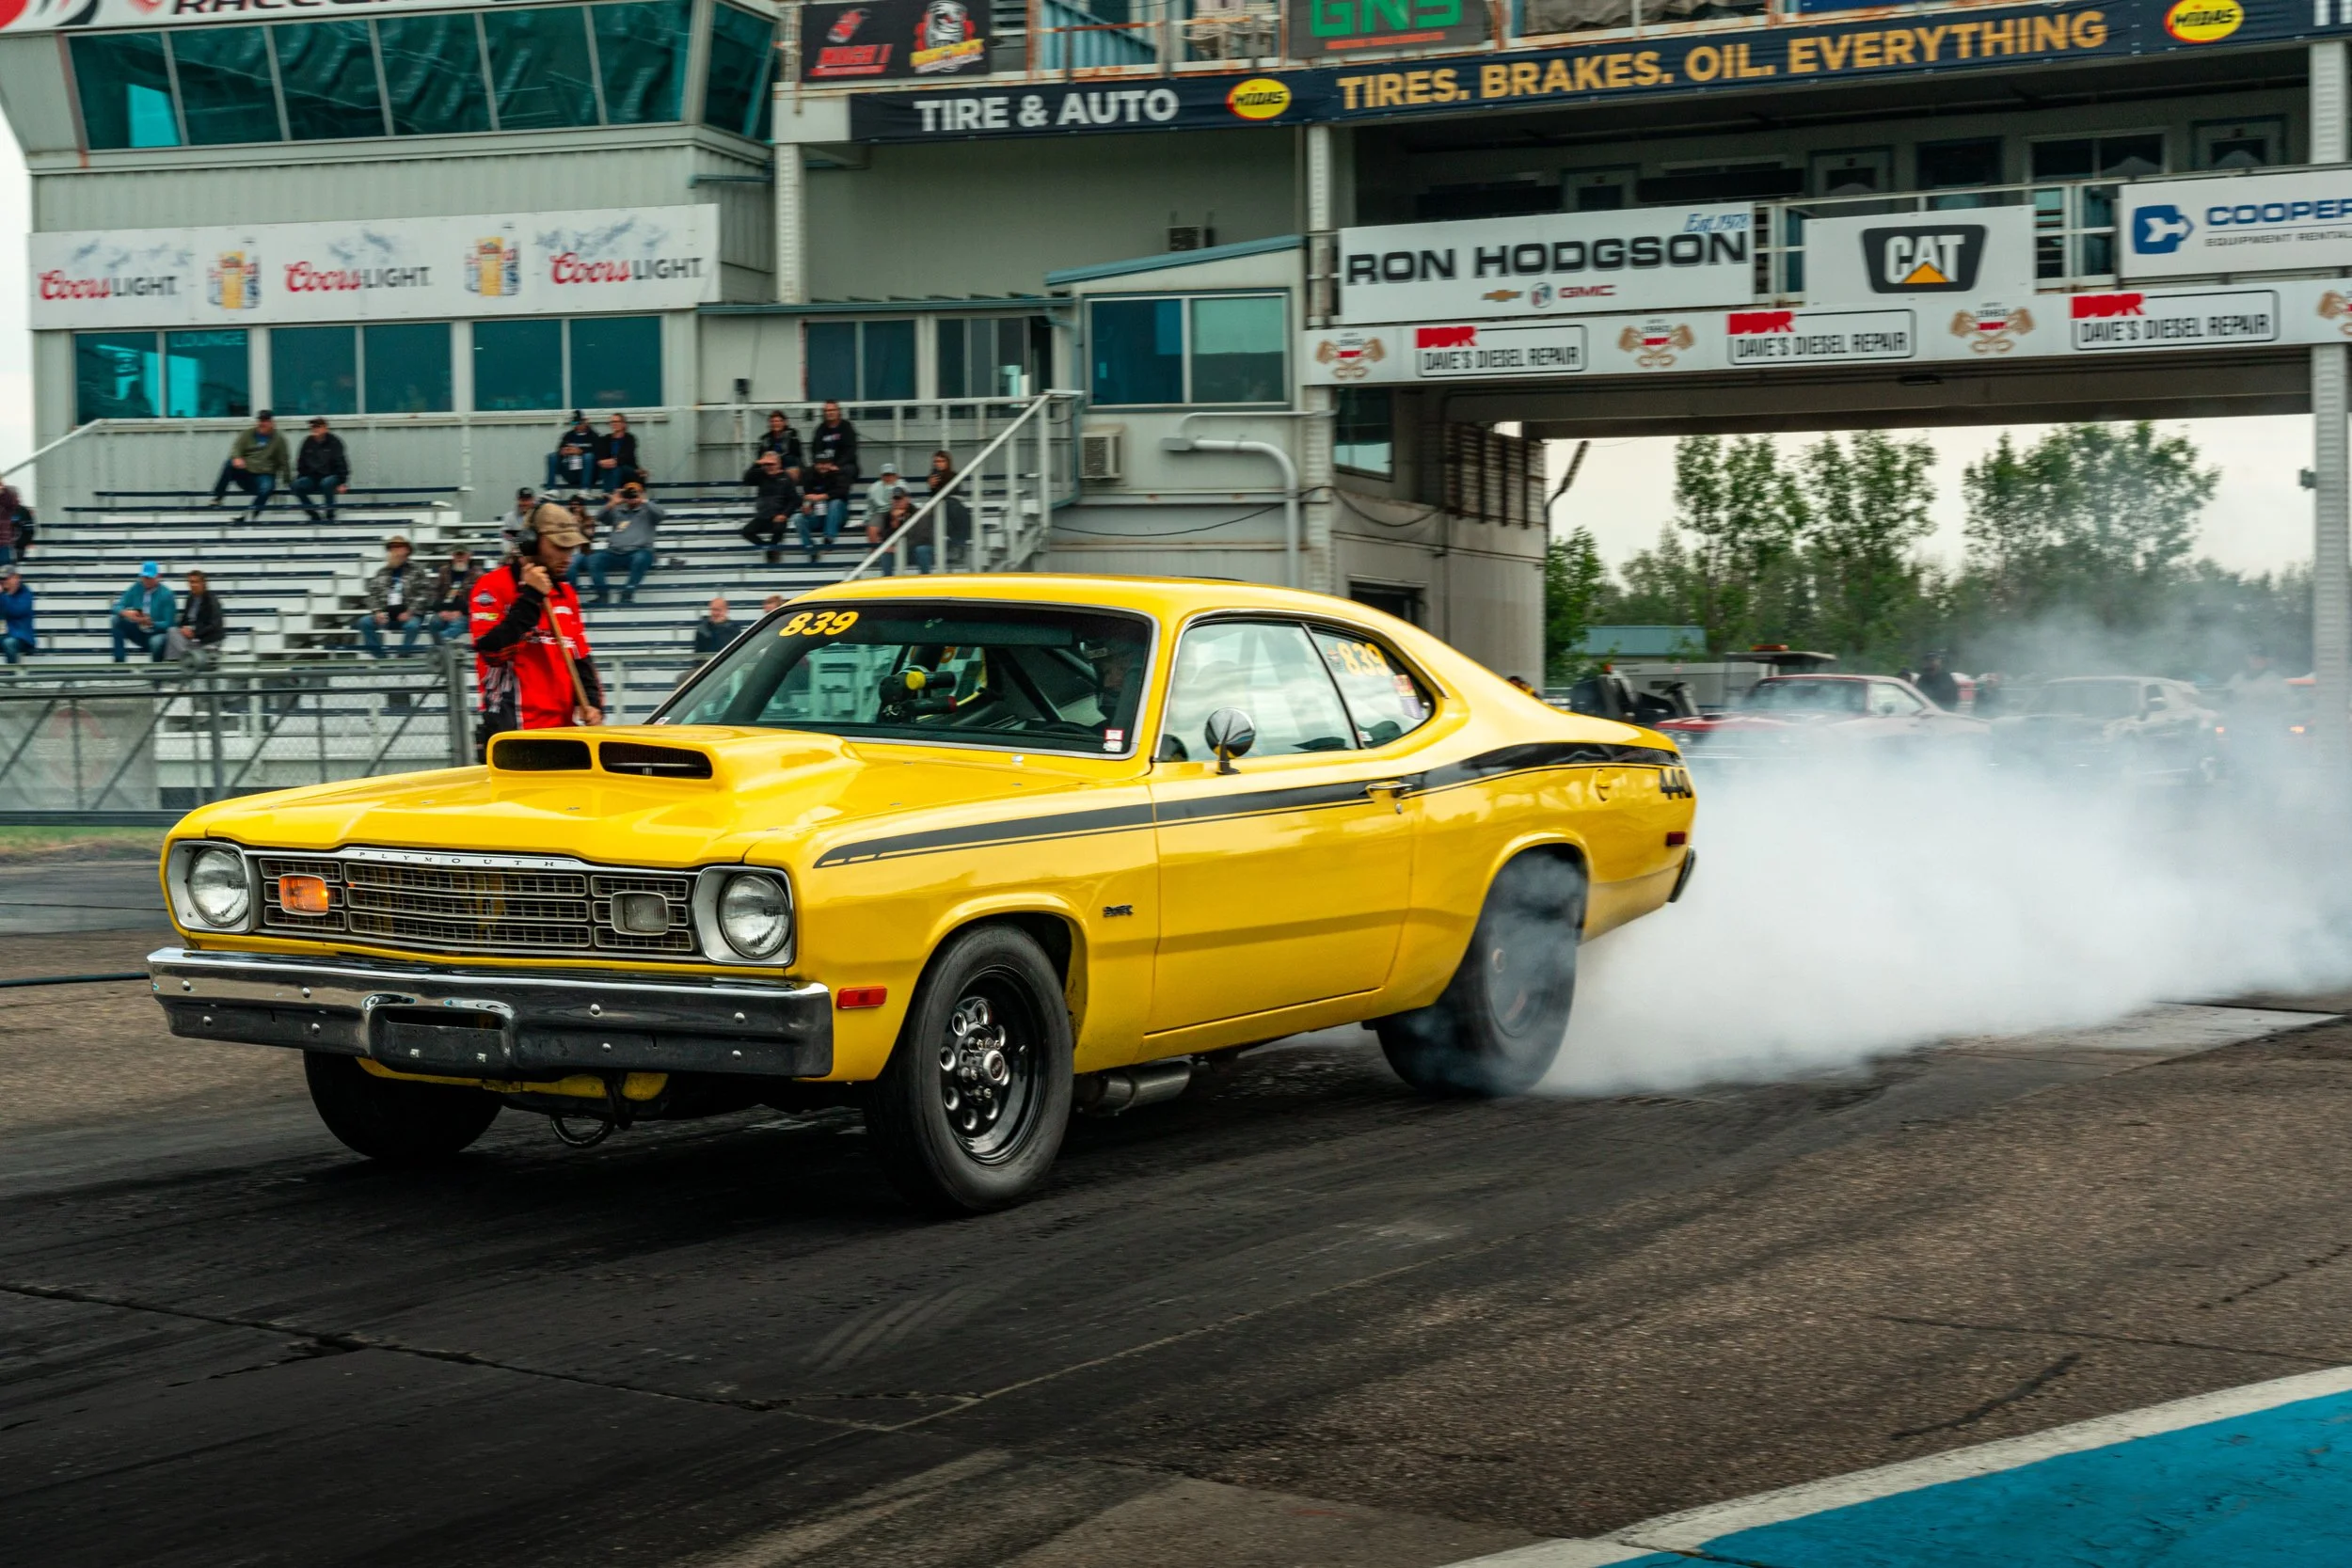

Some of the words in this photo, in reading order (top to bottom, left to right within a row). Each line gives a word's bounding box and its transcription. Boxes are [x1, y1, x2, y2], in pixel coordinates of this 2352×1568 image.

[1336, 68, 1470, 110] TIRES.
[1480, 51, 1675, 98] BRAKES.
[1685, 43, 1776, 82] OIL.
[1789, 10, 2107, 73] EVERYTHING
[913, 96, 1010, 132] TIRE
[1017, 95, 1049, 127] &
[1056, 88, 1180, 125] AUTO
[549, 252, 632, 284] Coors
[632, 256, 705, 280] LIGHT
[1345, 248, 1456, 286] RON
[1472, 231, 1748, 278] HODGSON
[1884, 234, 1966, 284] CAT
[37, 269, 111, 300] Coors
[111, 275, 180, 297] LIGHT
[284, 261, 361, 293] Coors
[361, 266, 433, 289] LIGHT
[1558, 284, 1617, 299] GMC
[2080, 319, 2139, 342] DAVE'S
[2144, 316, 2204, 341] DIESEL
[2208, 312, 2271, 337] REPAIR
[1422, 349, 1472, 371] DAVE'S
[1475, 348, 1525, 369] DIESEL
[1528, 345, 1580, 367] REPAIR
[1737, 336, 1790, 358] DAVE'S
[1794, 333, 1848, 356] DIESEL
[1851, 330, 1908, 354] REPAIR
[778, 610, 860, 637] 839
[1337, 641, 1390, 676] 839
[358, 851, 555, 867] PLYMOUTH
